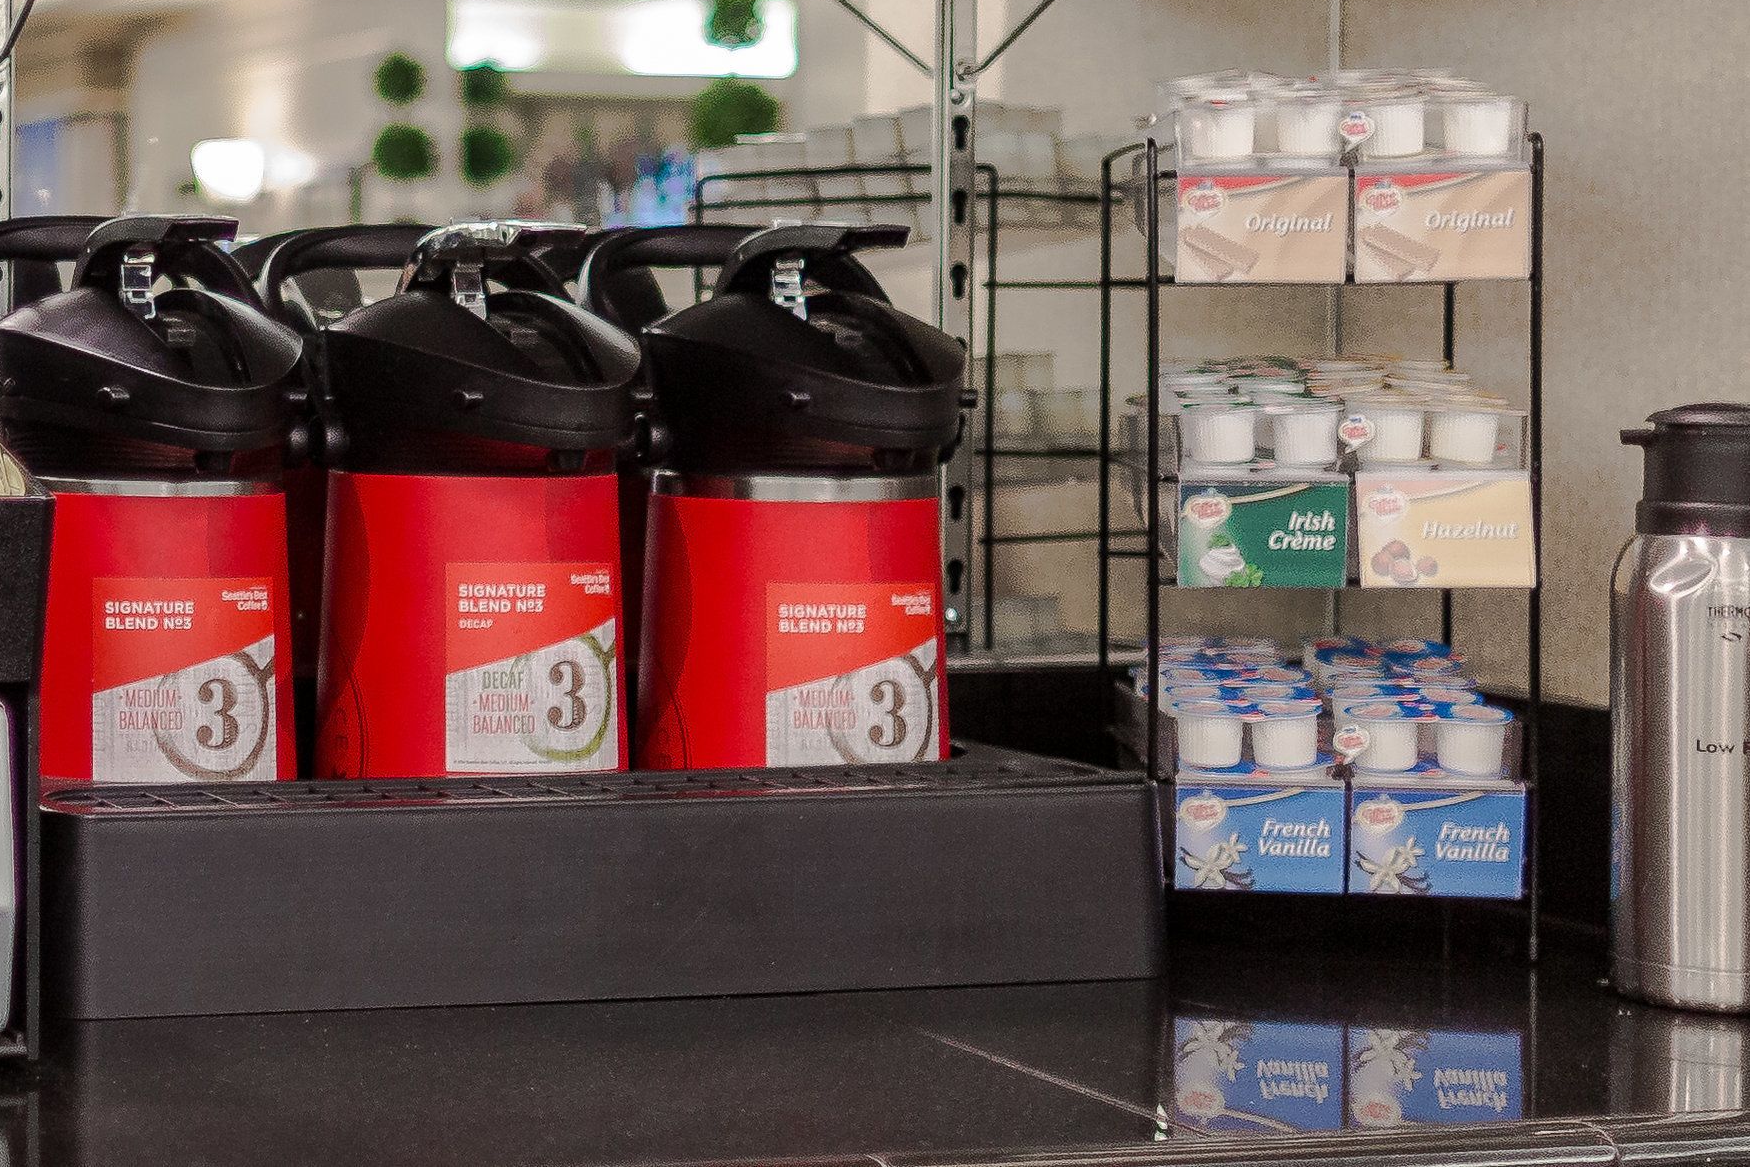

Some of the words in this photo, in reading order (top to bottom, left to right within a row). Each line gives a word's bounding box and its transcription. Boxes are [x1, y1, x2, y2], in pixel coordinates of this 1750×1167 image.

[1245, 212, 1334, 233] Original
[1425, 209, 1515, 233] Original
[1287, 510, 1337, 531] Irish
[1421, 520, 1519, 540] Hazelnut
[1268, 529, 1337, 552] Crème
[458, 583, 547, 597] SIGNATURE
[104, 600, 195, 615] SIGNATURE
[458, 599, 512, 613] BLEND
[778, 604, 867, 619] SIGNATURE
[104, 617, 159, 630] BLEND
[458, 618, 494, 630] DECAF
[778, 619, 833, 633] BLEND
[482, 671, 525, 690] DECAF
[125, 689, 177, 708] MEDIUM
[479, 694, 529, 713] MEDIUM
[547, 660, 587, 731] 3
[799, 690, 850, 708] MEDIUM
[118, 710, 184, 731] BALANCED
[196, 678, 240, 751] 3
[793, 710, 857, 730] BALANCED
[869, 679, 907, 747] 3
[473, 714, 536, 734] BALANCED
[1696, 739, 1736, 754] Low
[1261, 817, 1331, 837] French
[1440, 821, 1510, 842] French
[1257, 838, 1331, 859] Vanilla
[1435, 842, 1510, 863] Vanilla
